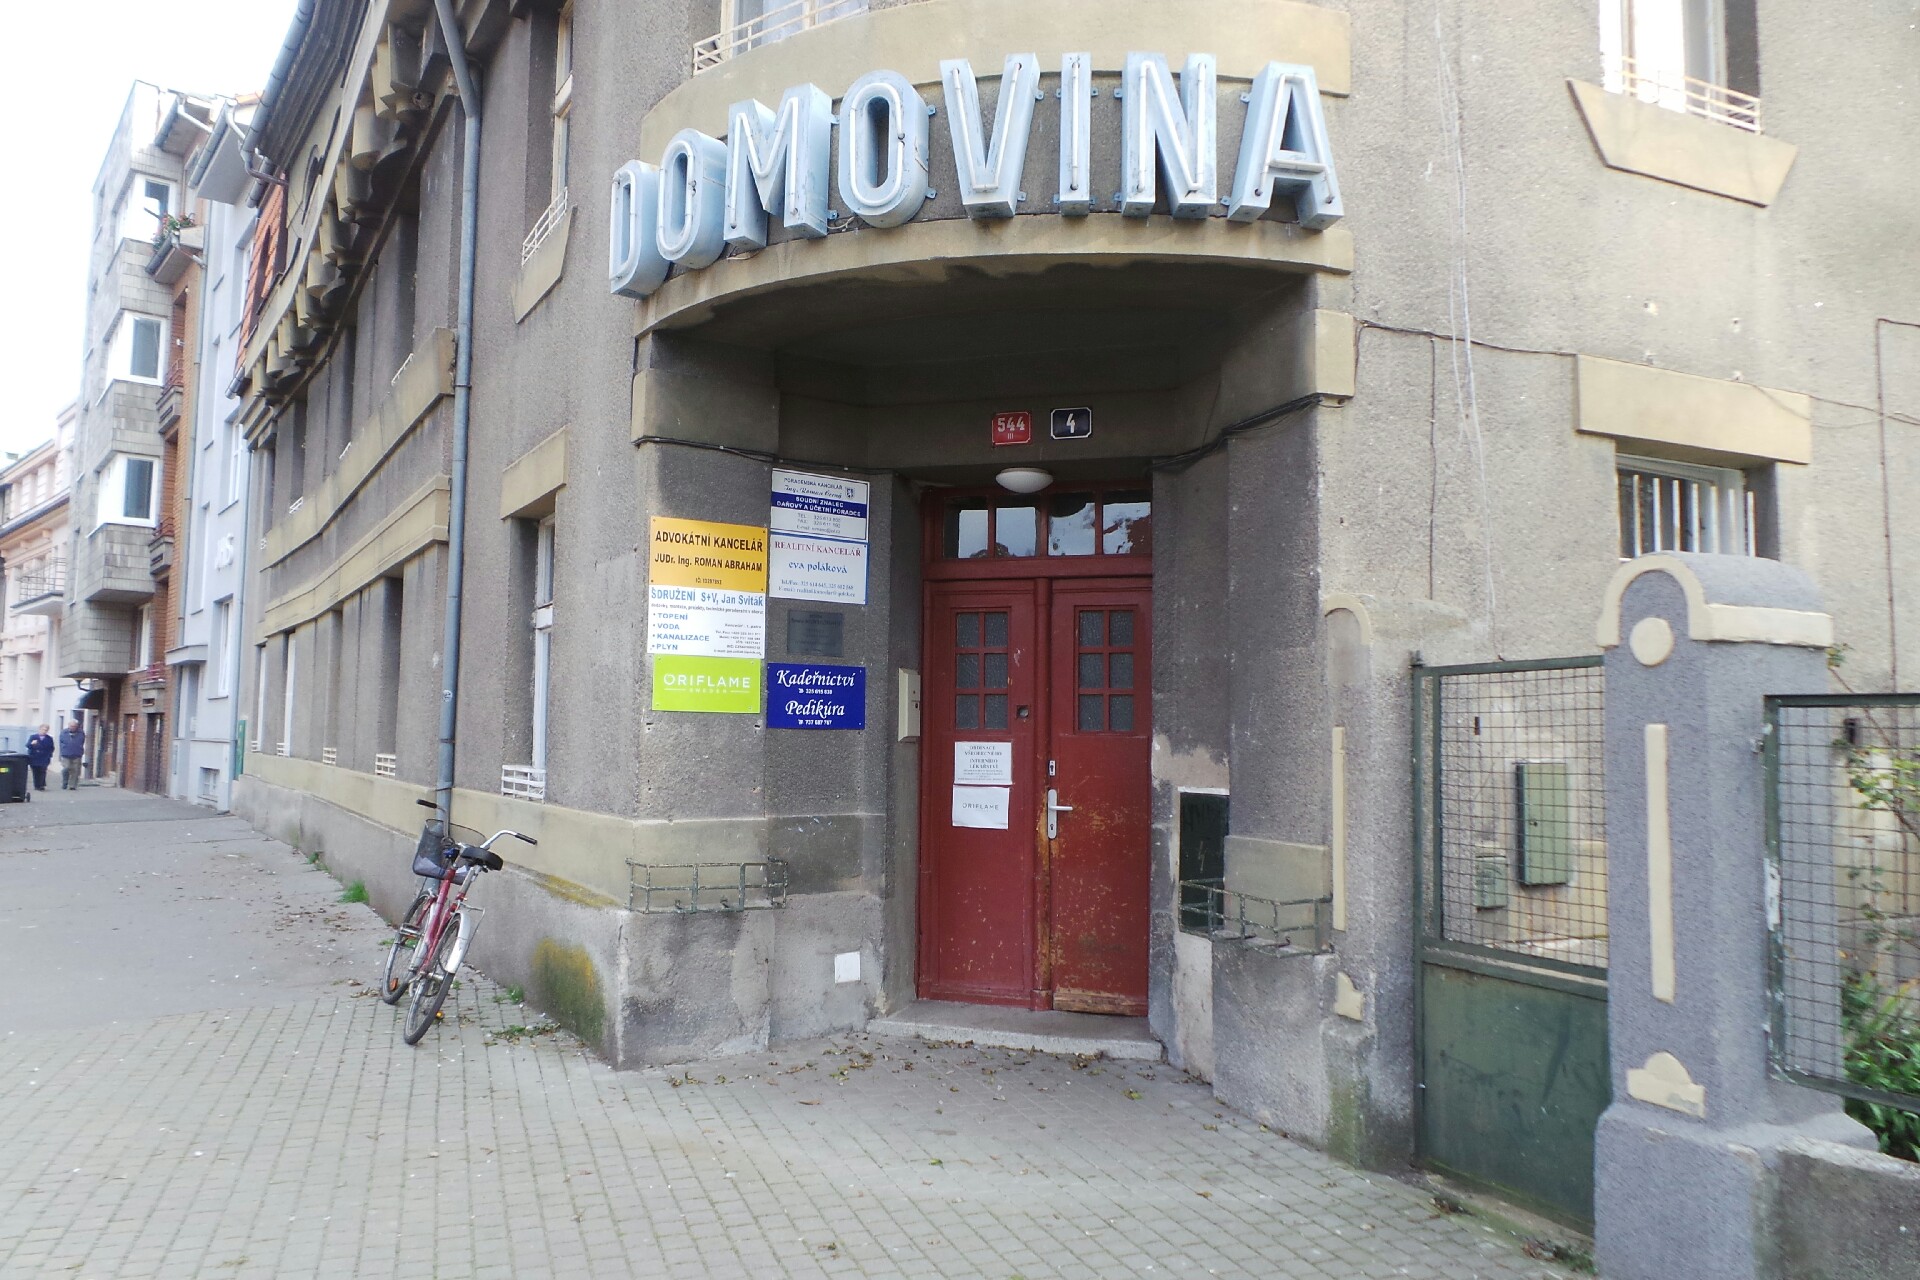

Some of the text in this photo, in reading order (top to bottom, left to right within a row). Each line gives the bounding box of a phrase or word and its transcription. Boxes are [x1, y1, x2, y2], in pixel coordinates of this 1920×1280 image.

[609, 52, 1344, 299] DOMOVINA
[997, 416, 1025, 432] 544
[1066, 413, 1076, 434] 4
[777, 500, 802, 509] DAŇOVÝ
[810, 504, 832, 514] ÚČETNÍ
[832, 508, 861, 517] PORADCE
[820, 499, 843, 508] ZNALEC
[656, 530, 763, 552] ADVOKÁTNÍ KANCELÁŘ
[775, 541, 861, 557] REALITNÍ KANCELÁŘ
[655, 553, 762, 572] JUDr. Ing. ROMAN ABRAHAM
[788, 561, 848, 573] eva poláková
[722, 594, 736, 604] Jan
[658, 612, 688, 620] TOPENÍ
[656, 633, 709, 642] KANALIZACE
[663, 674, 751, 688] ORIFLAME
[776, 669, 856, 688] Kadeřnictví
[785, 699, 845, 719] Pedikúra
